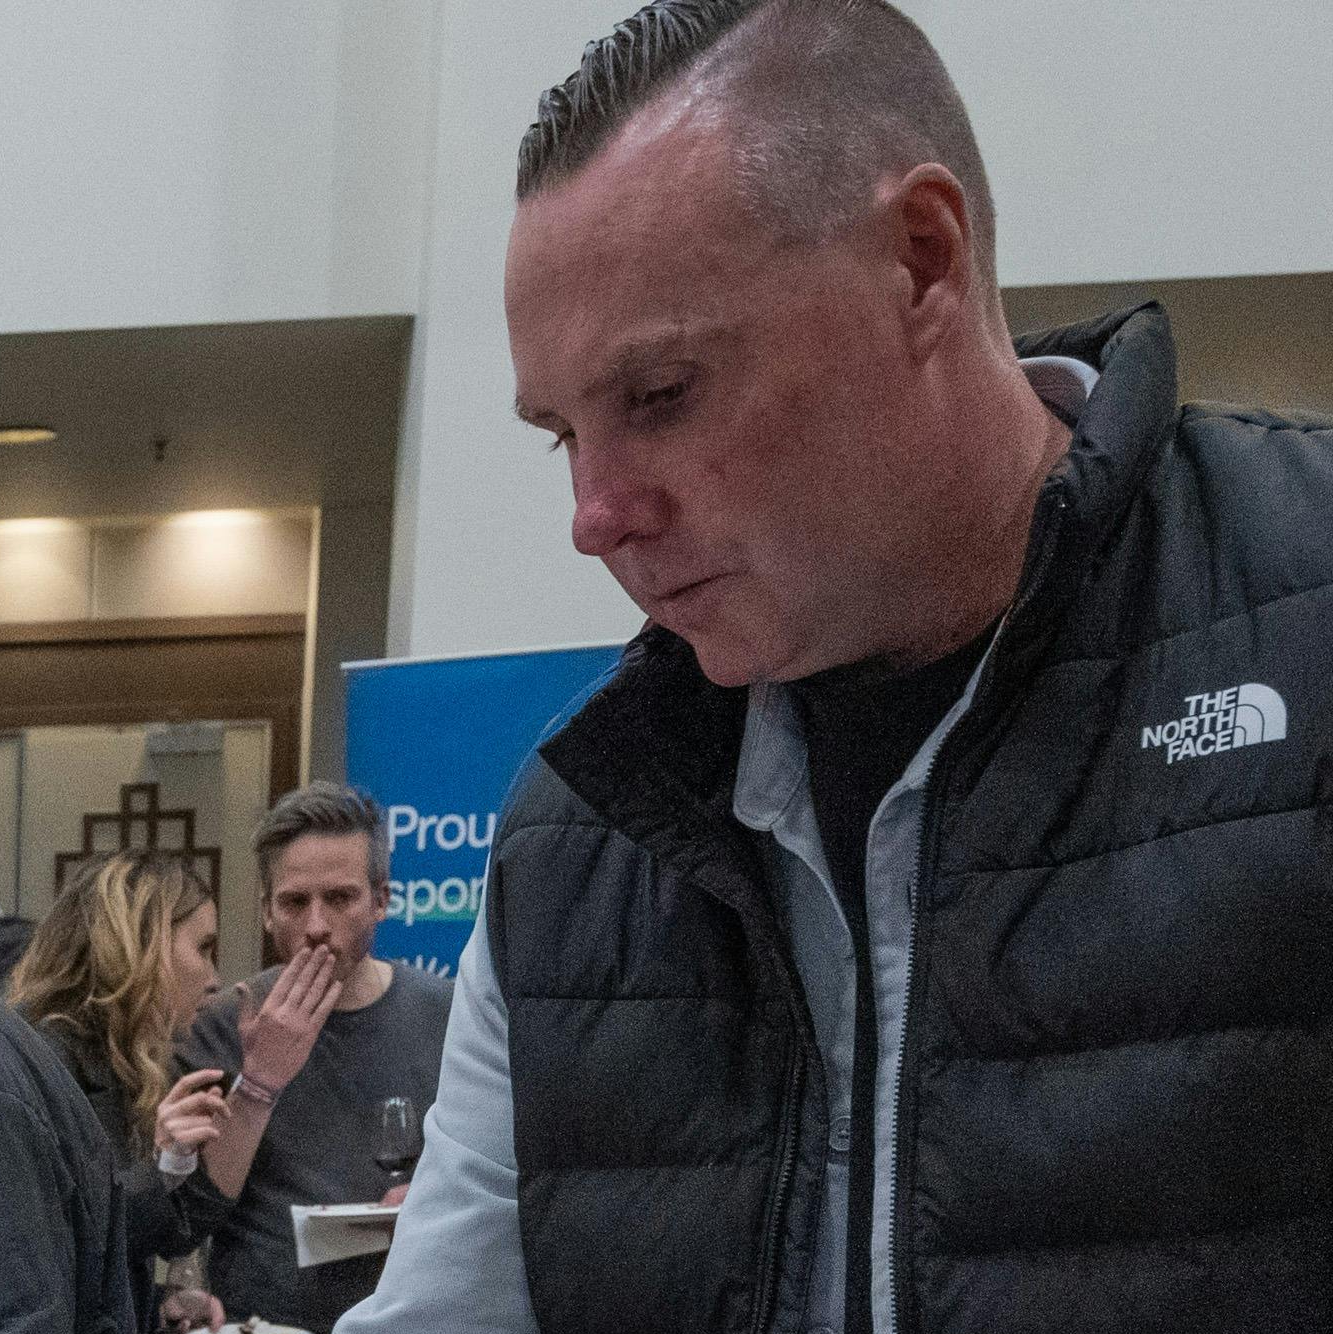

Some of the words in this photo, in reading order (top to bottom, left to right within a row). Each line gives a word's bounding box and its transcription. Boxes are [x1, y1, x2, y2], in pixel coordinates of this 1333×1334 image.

[1184, 686, 1239, 716] THE
[1140, 708, 1236, 749] NORTH
[1166, 729, 1233, 765] FACE
[388, 804, 497, 853] Prou
